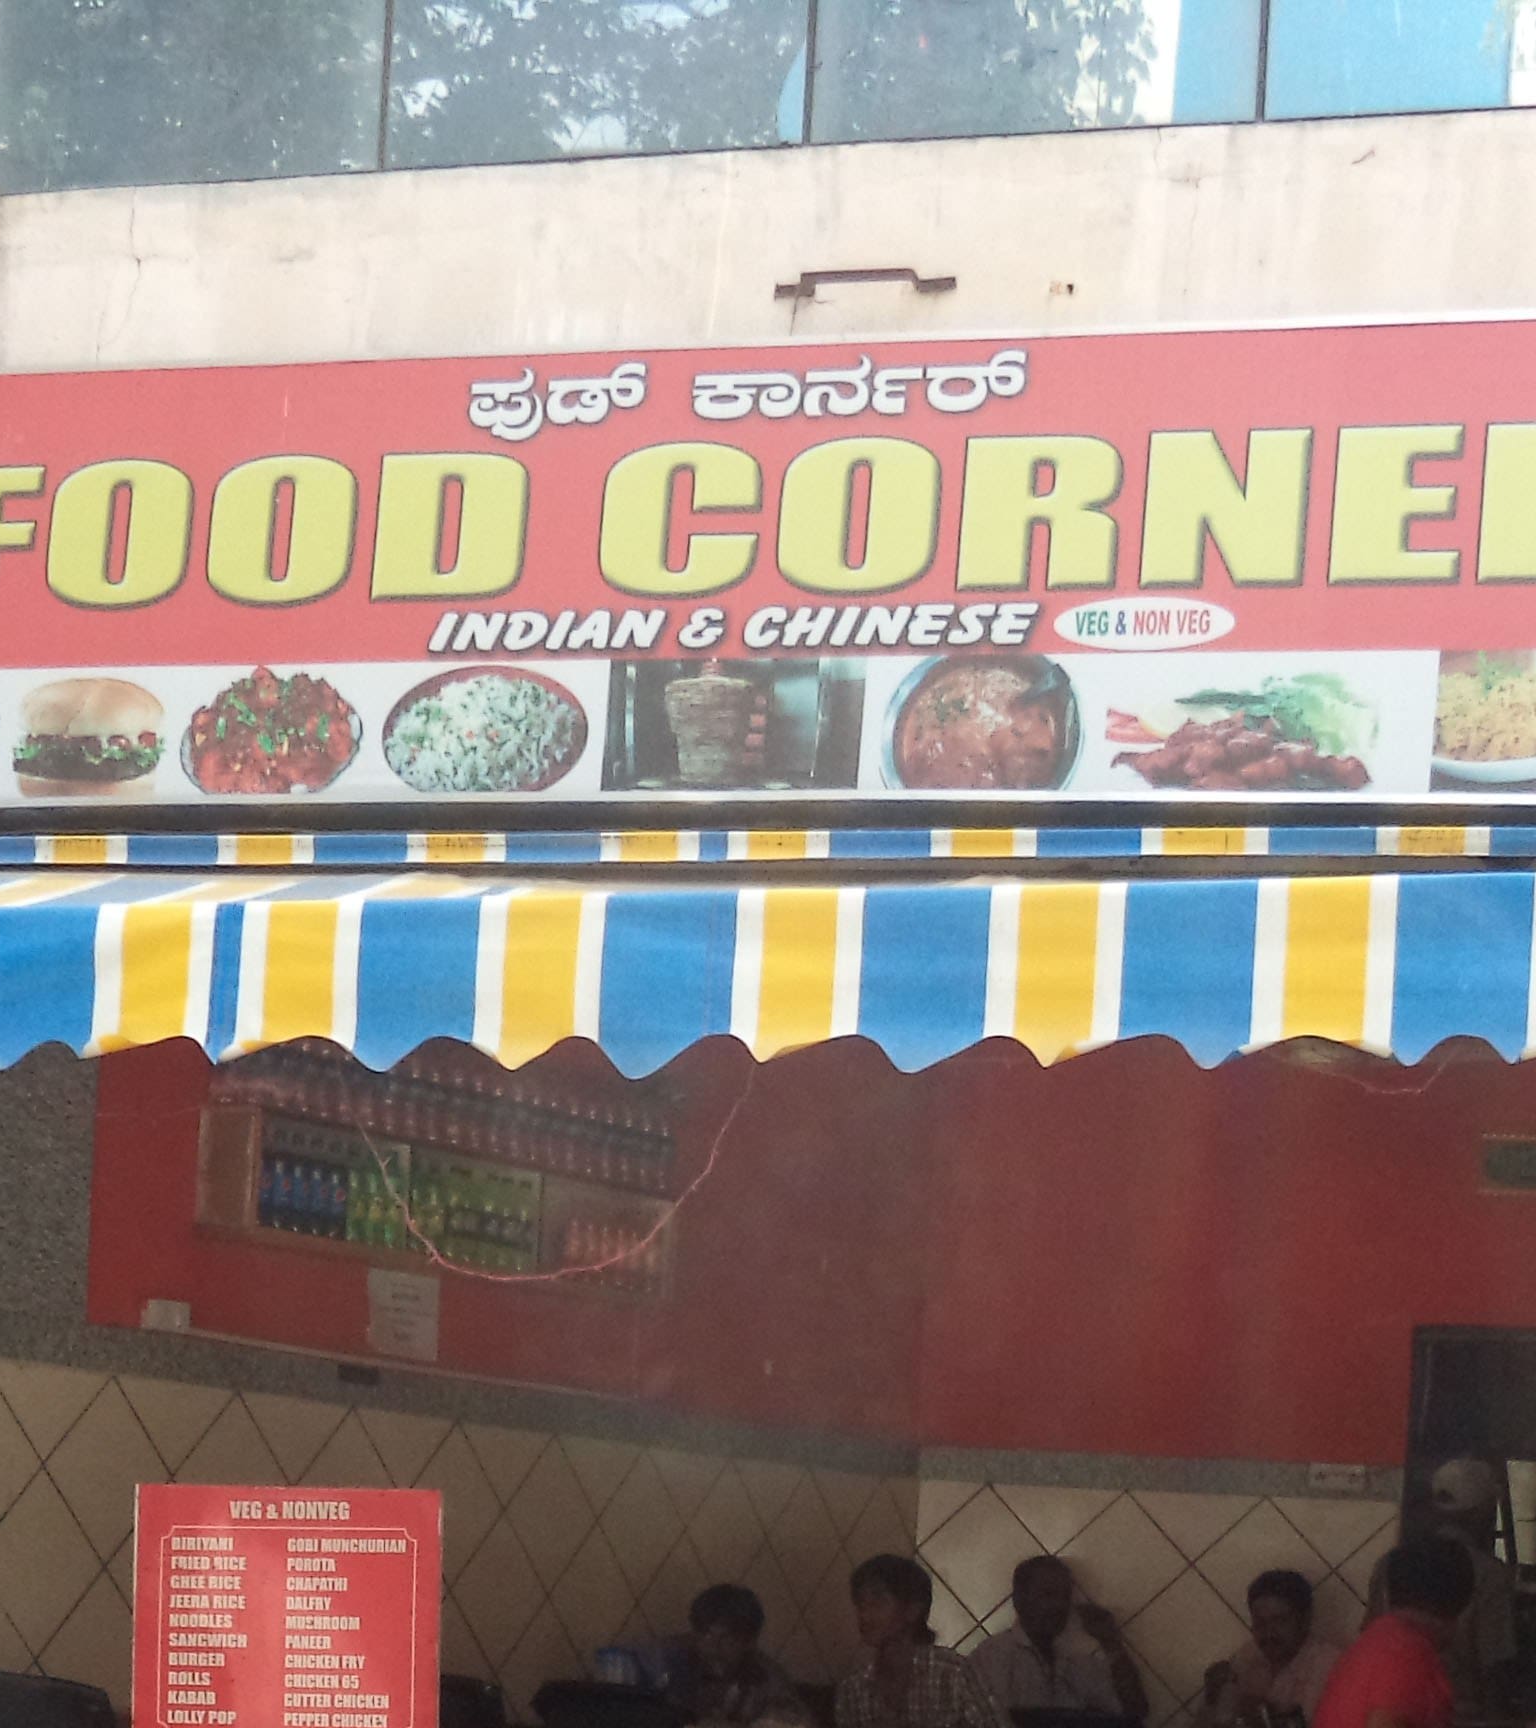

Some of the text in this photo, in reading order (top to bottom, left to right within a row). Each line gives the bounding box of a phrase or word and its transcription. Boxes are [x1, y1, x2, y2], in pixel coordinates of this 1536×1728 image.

[429, 602, 1040, 651] INDIAN & CHINESE
[1075, 609, 1211, 637] VEG & NON VEG
[230, 1501, 350, 1521] VEG & NONVEG
[170, 1536, 234, 1551] BIRIYANI
[287, 1538, 318, 1553] GOBI
[170, 1555, 247, 1571] FRIED RICE
[287, 1557, 337, 1573] POROTA
[170, 1575, 241, 1590] GHEE RICE
[286, 1576, 348, 1592] CHAPATHI
[169, 1594, 247, 1609] JEERA RICE
[169, 1613, 233, 1628] NOODLES
[285, 1615, 361, 1630] MUSHROOM
[285, 1634, 332, 1650] PANEER
[168, 1651, 225, 1667] BURGER
[284, 1653, 366, 1670] CHICKEN FRY
[167, 1670, 211, 1686] ROLLS
[284, 1673, 360, 1690] CHICKEN 65
[167, 1690, 216, 1705] KABAB
[333, 1693, 390, 1710] CHICKEN
[167, 1709, 237, 1725] LOLLY POP
[284, 1711, 388, 1728] PEPPER CHICKEN
